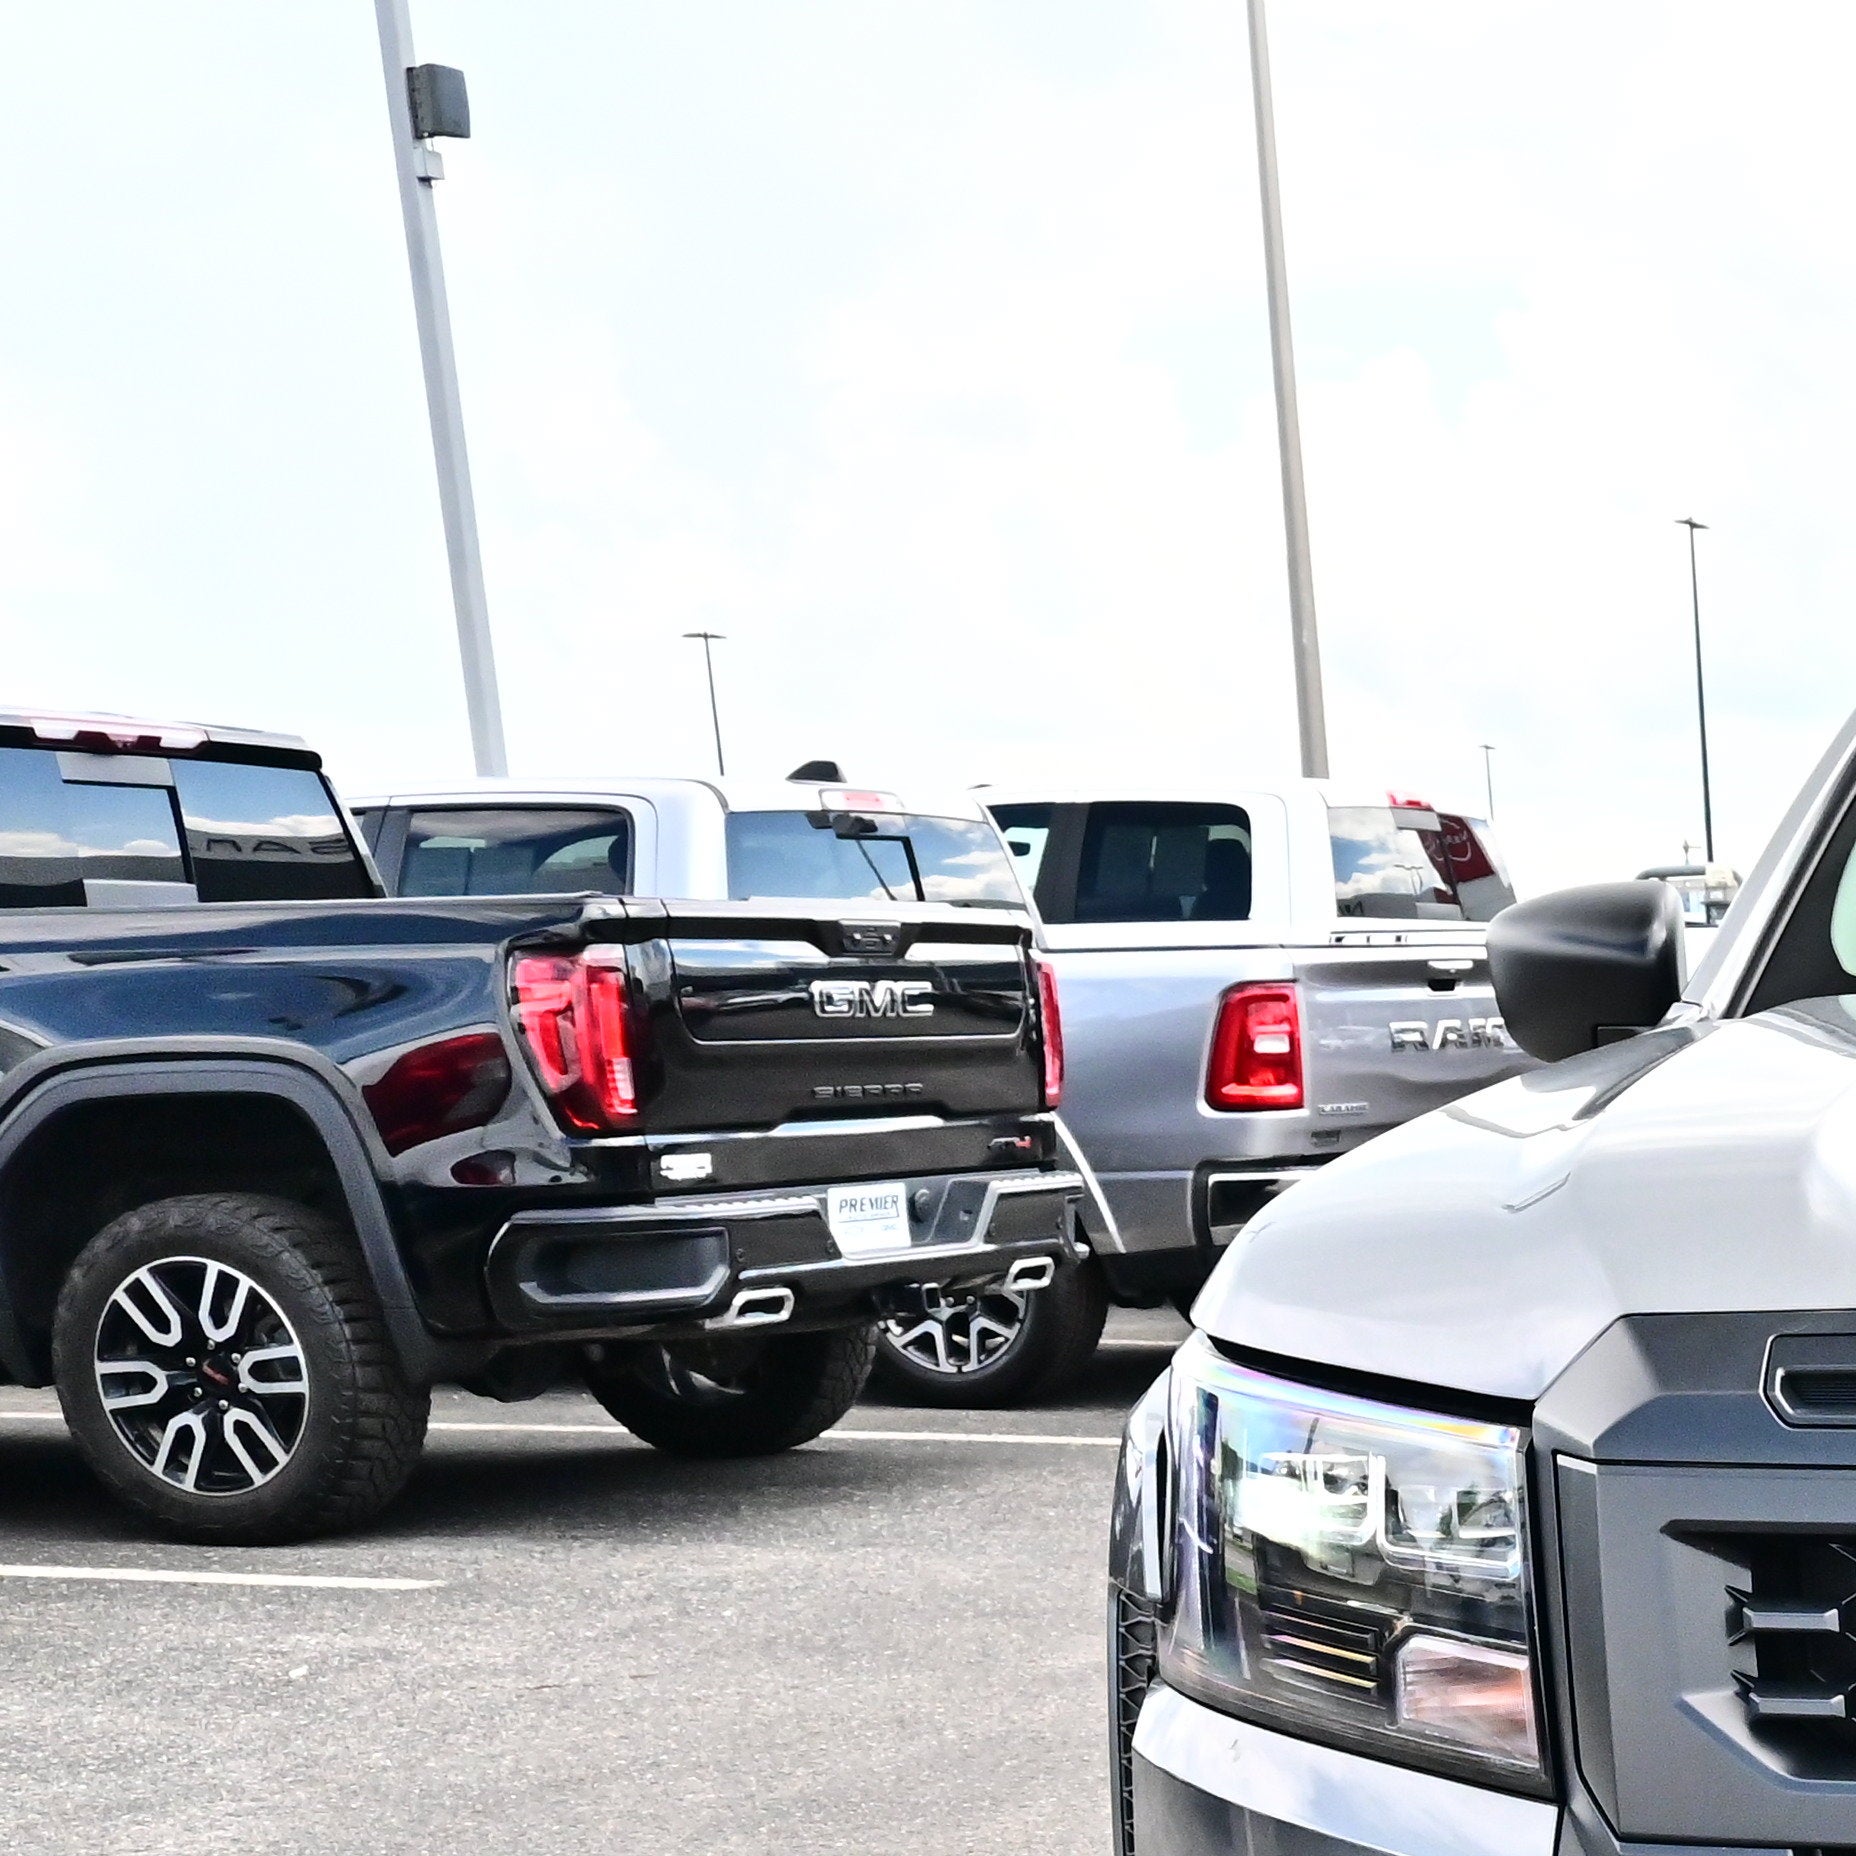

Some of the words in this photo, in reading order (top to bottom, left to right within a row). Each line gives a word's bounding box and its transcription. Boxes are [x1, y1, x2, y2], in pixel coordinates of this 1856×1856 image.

[809, 979, 936, 1019] GMC
[1388, 1016, 1507, 1052] RAM
[839, 1194, 899, 1214] PREMIER
